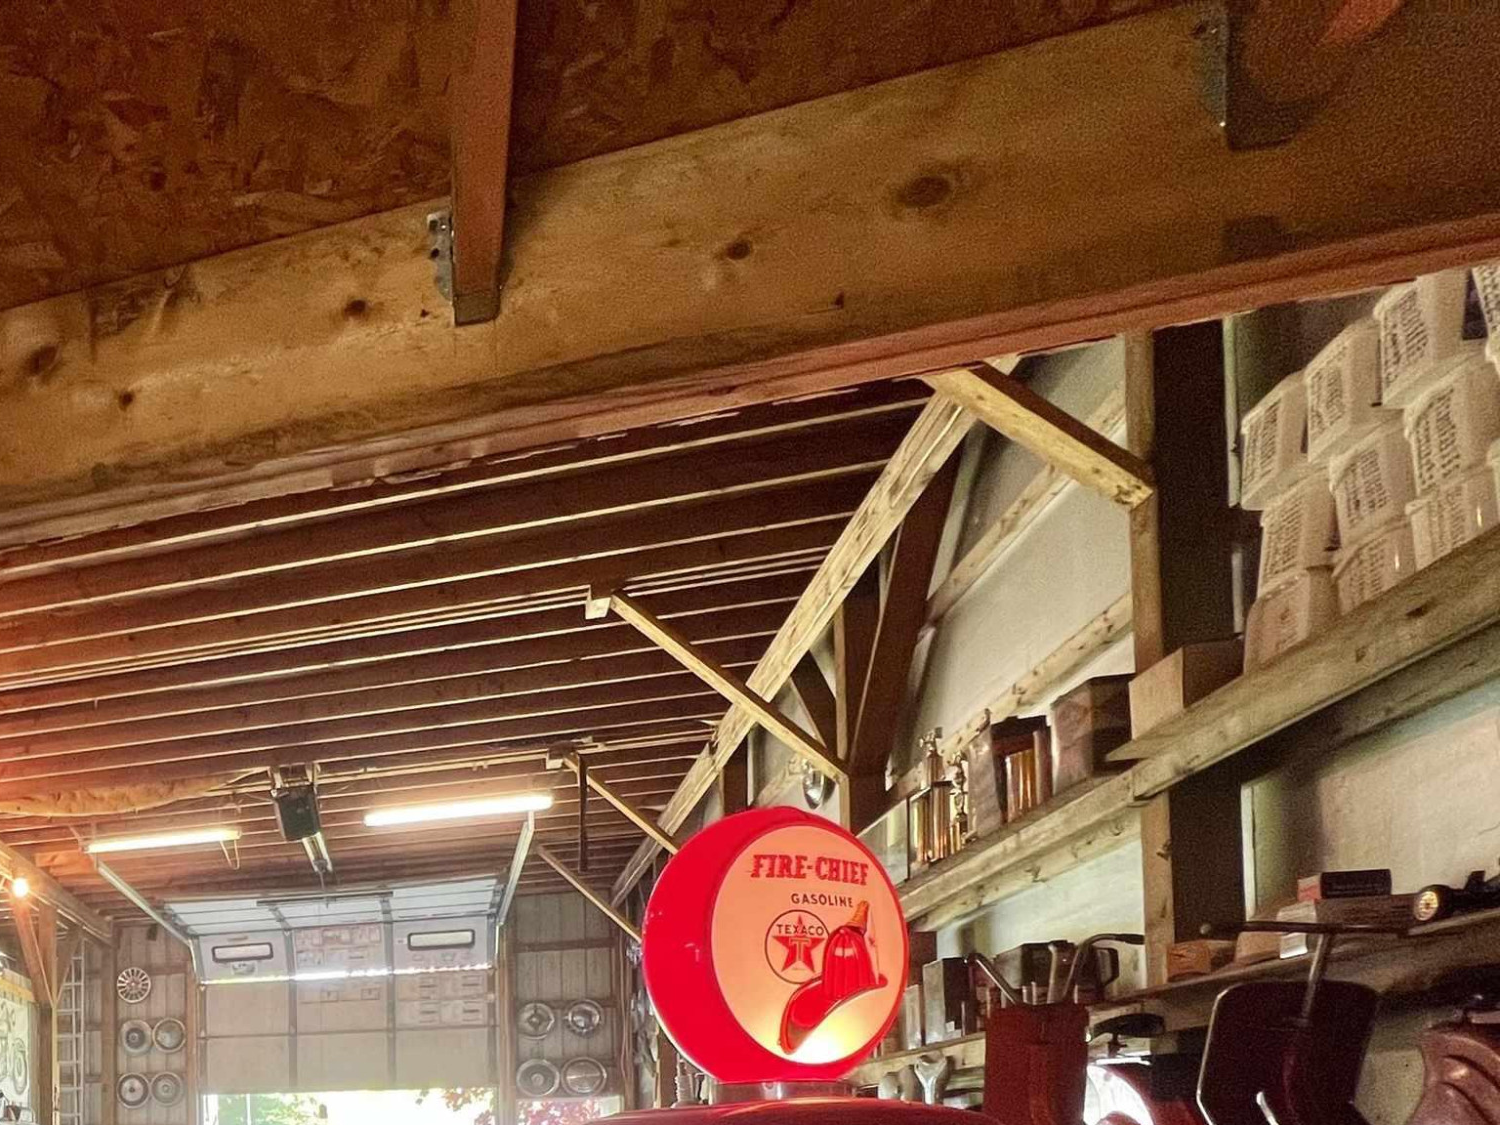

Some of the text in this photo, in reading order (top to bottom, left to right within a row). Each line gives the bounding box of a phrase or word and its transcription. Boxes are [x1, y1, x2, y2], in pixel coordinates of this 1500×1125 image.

[750, 854, 869, 886] FIRE-CHIEF
[791, 892, 854, 908] GASOLINE
[776, 923, 825, 937] TEXACO
